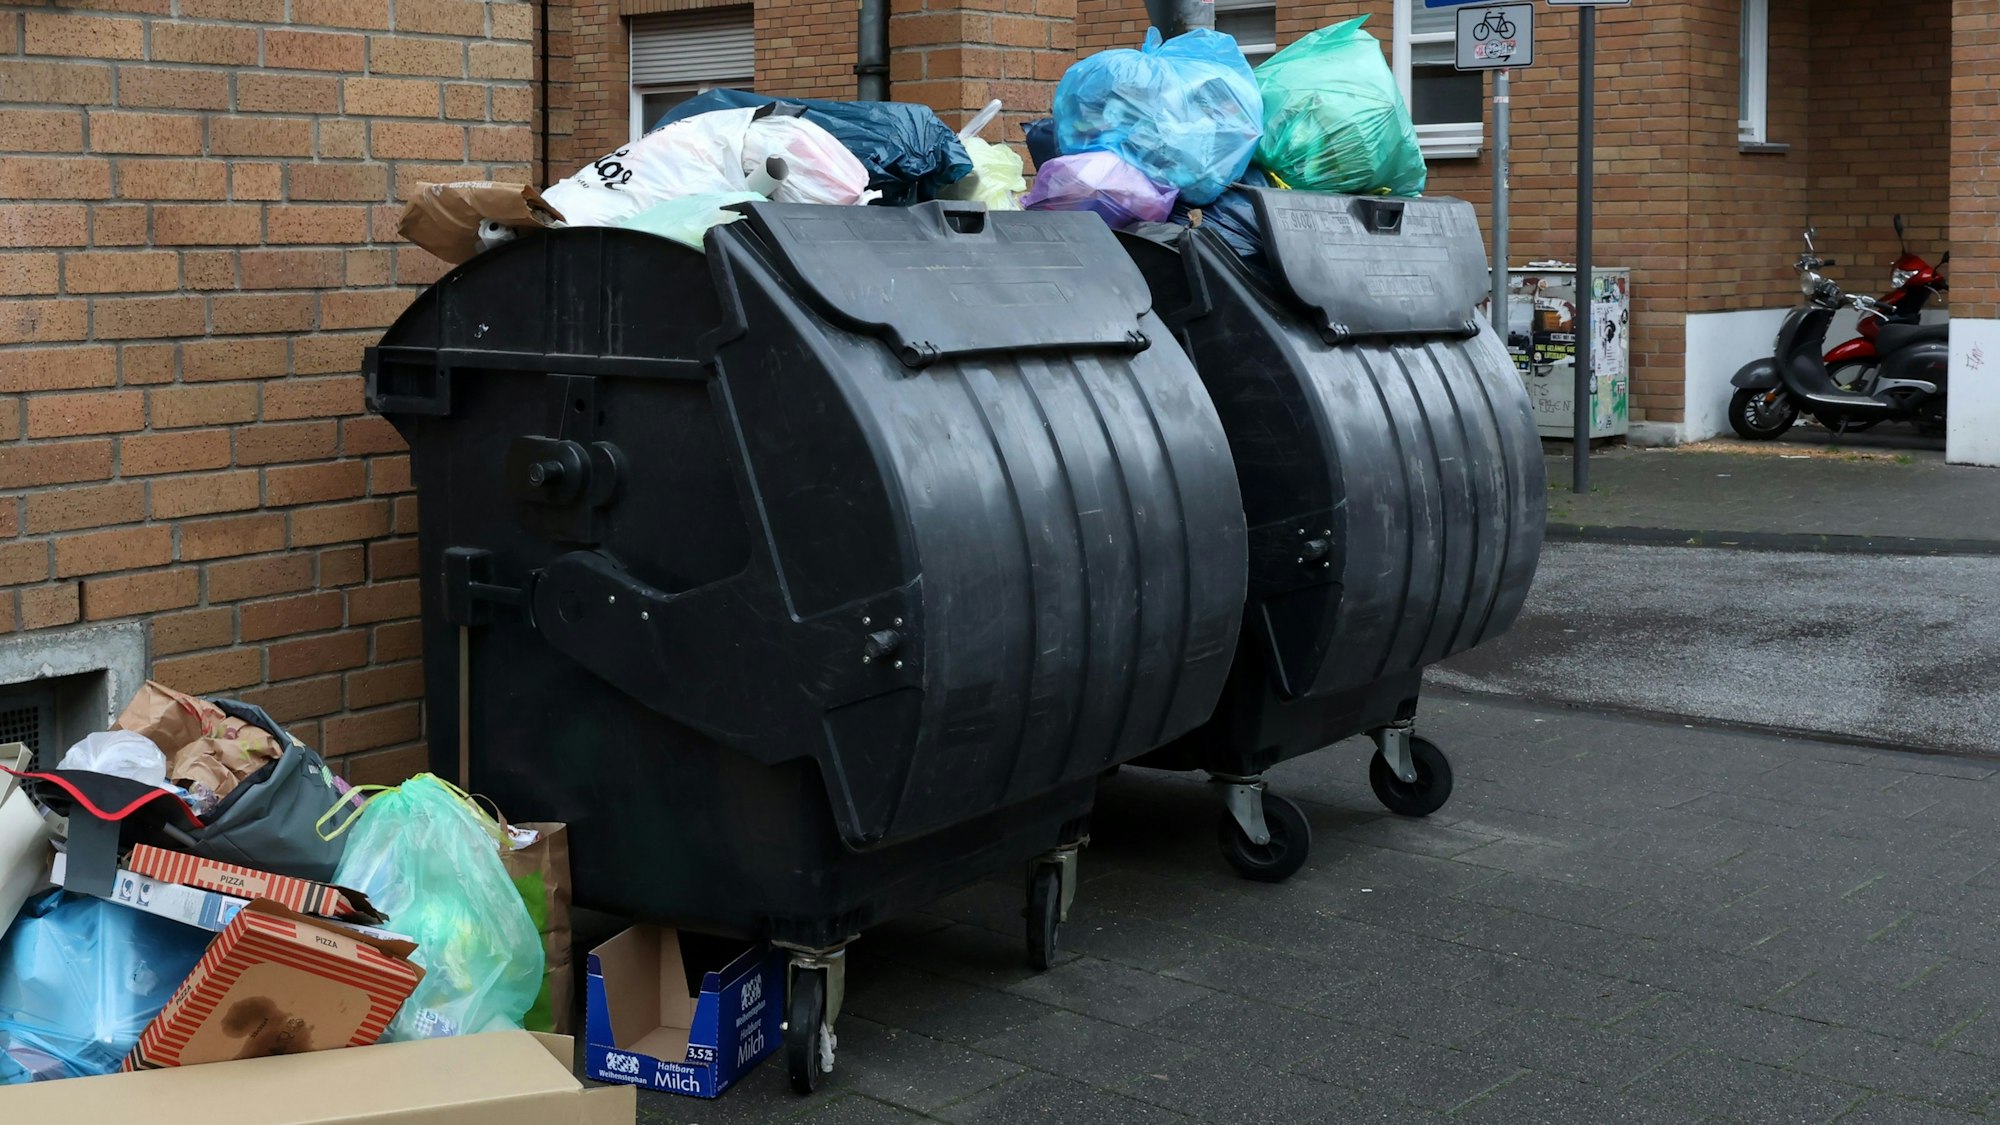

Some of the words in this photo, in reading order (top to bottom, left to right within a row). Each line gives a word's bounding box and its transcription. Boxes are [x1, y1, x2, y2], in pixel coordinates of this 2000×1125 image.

[219, 875, 244, 887] PIZZA
[315, 935, 338, 949] PIZZA
[175, 985, 192, 1005] PIZZA
[737, 1029, 764, 1068] Milch
[657, 1062, 695, 1075] Haltbare
[598, 1069, 648, 1085] Weihenstephan
[654, 1071, 700, 1093] Milch
